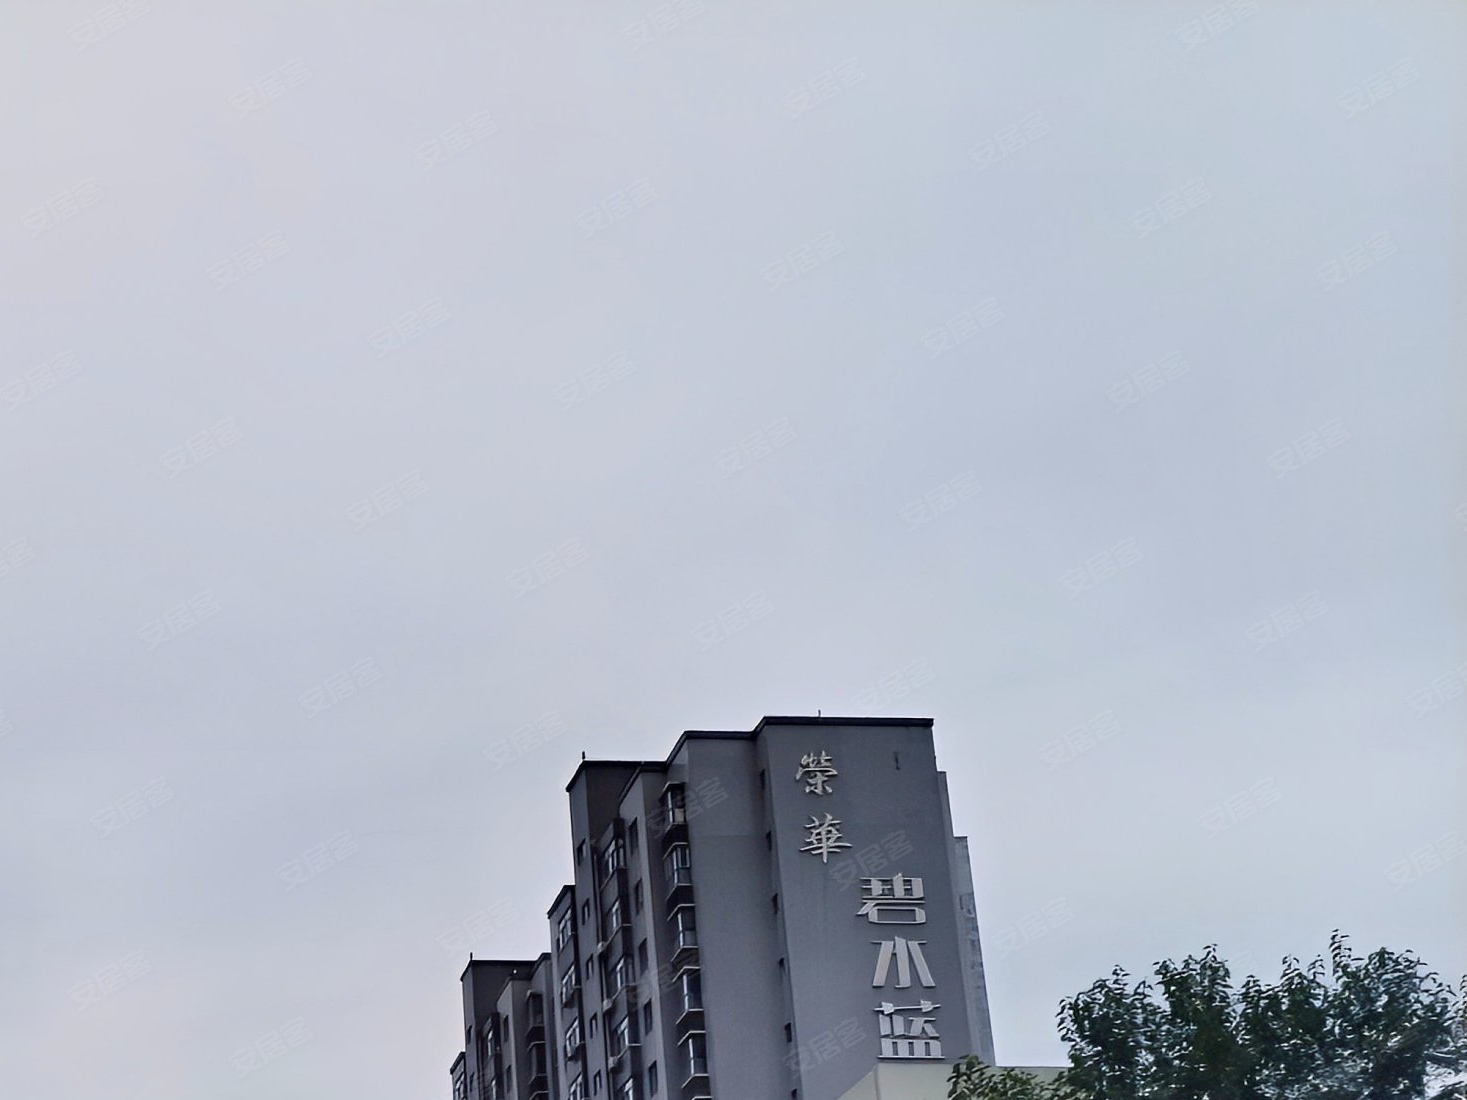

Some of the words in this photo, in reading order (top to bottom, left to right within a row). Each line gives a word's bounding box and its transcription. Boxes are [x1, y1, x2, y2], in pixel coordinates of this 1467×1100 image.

[795, 750, 853, 864] 榮華
[856, 873, 946, 1060] 碧水蓝
